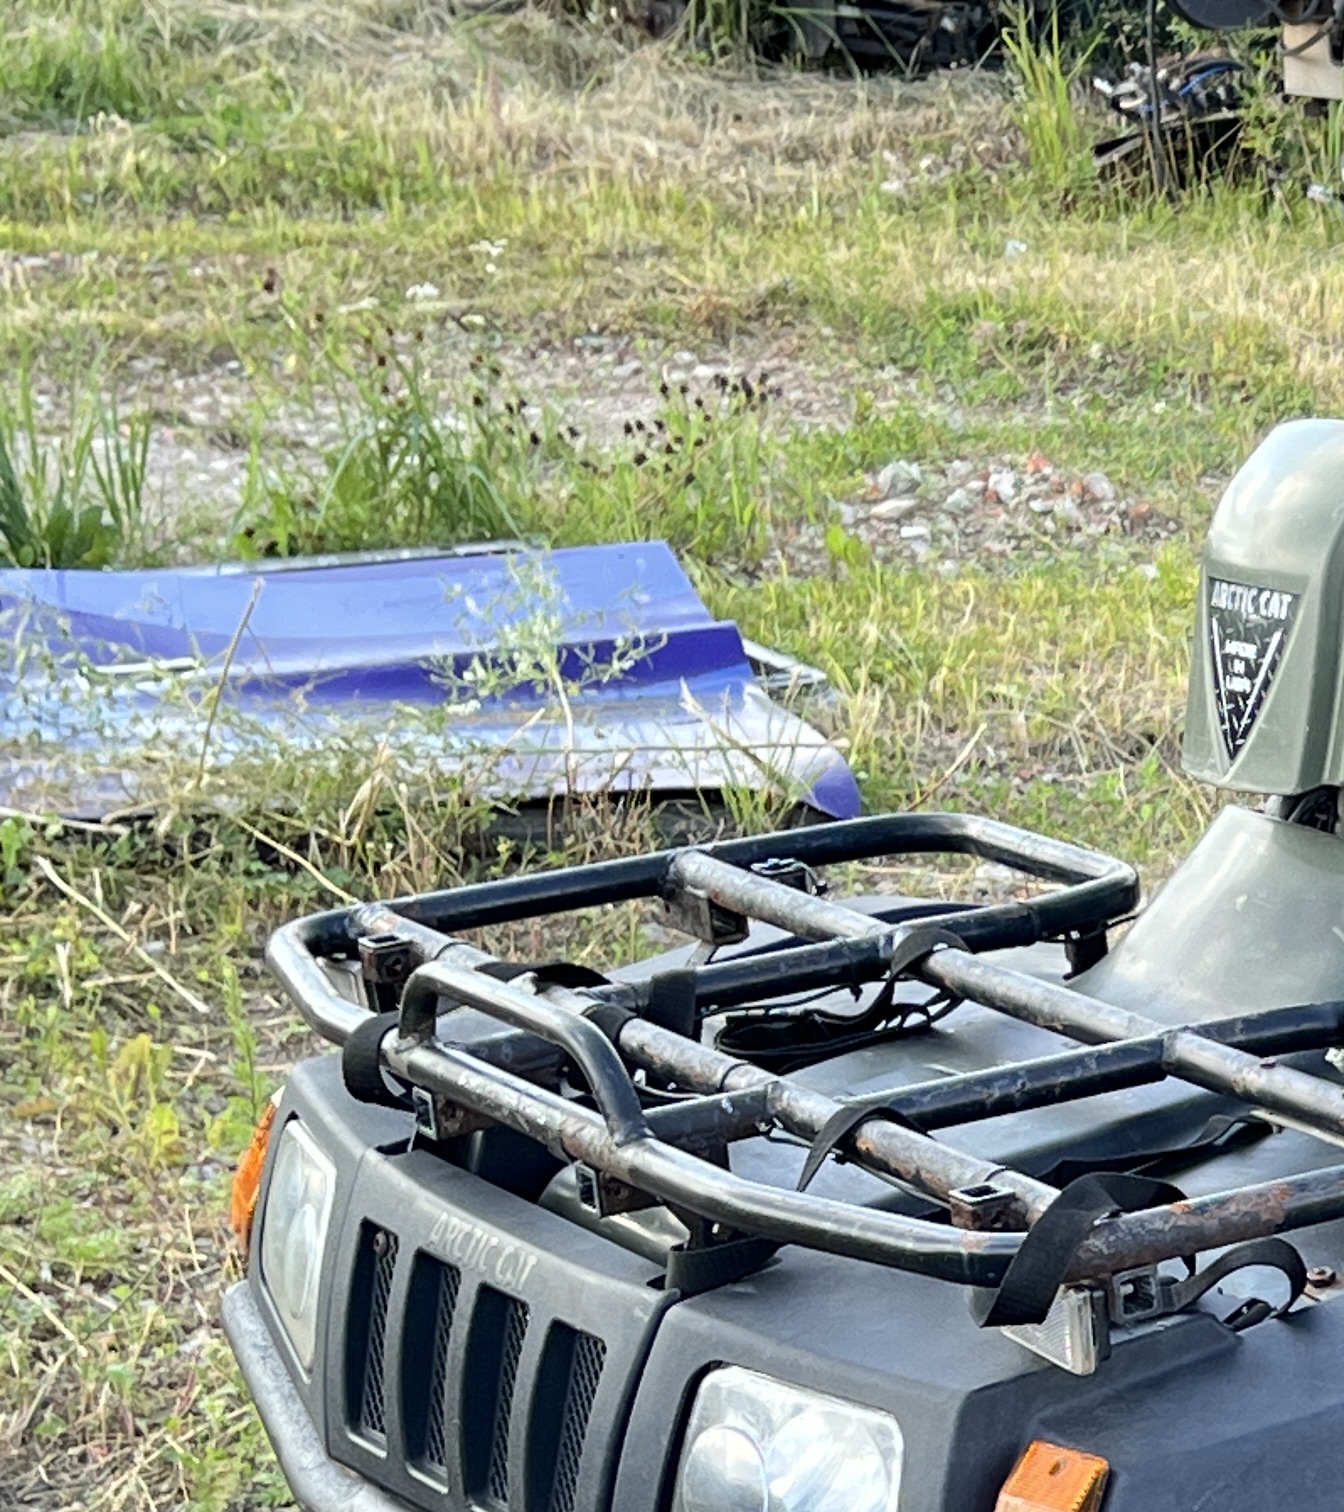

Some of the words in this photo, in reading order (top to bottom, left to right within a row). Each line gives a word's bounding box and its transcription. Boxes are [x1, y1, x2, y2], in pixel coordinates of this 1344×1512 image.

[1211, 581, 1258, 615] ARCTIC
[1259, 591, 1292, 620] CAT
[430, 1212, 498, 1270] ARCTIC
